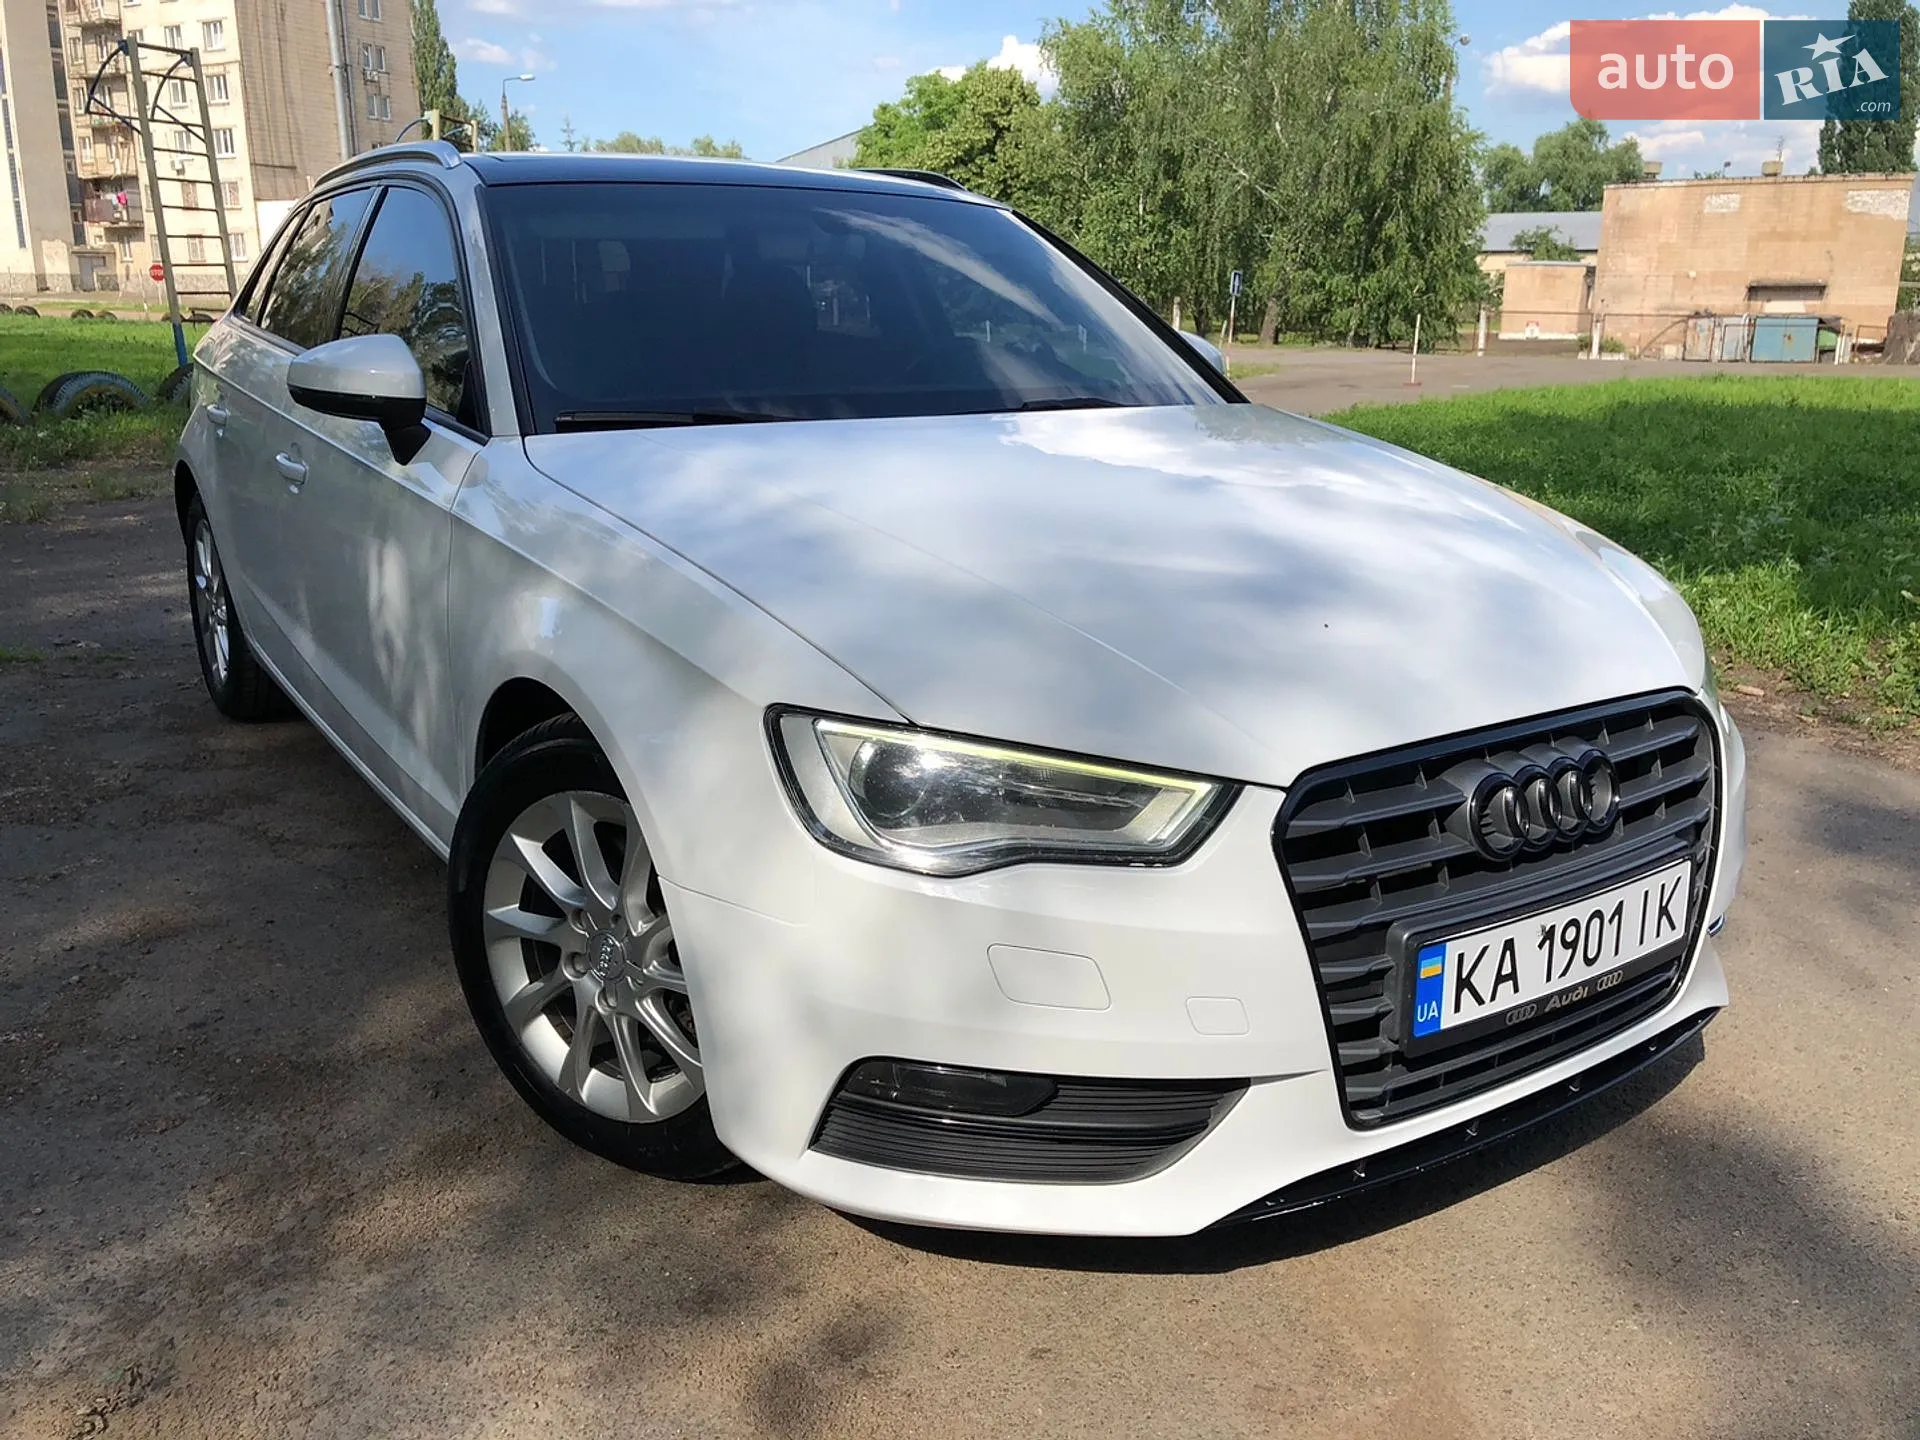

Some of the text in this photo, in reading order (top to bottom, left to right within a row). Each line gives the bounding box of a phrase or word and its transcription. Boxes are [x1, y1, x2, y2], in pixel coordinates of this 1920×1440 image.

[1453, 875, 1682, 1014] KA 1901 IK
[1416, 1000, 1439, 1023] UA
[1544, 985, 1589, 1013] Audi
